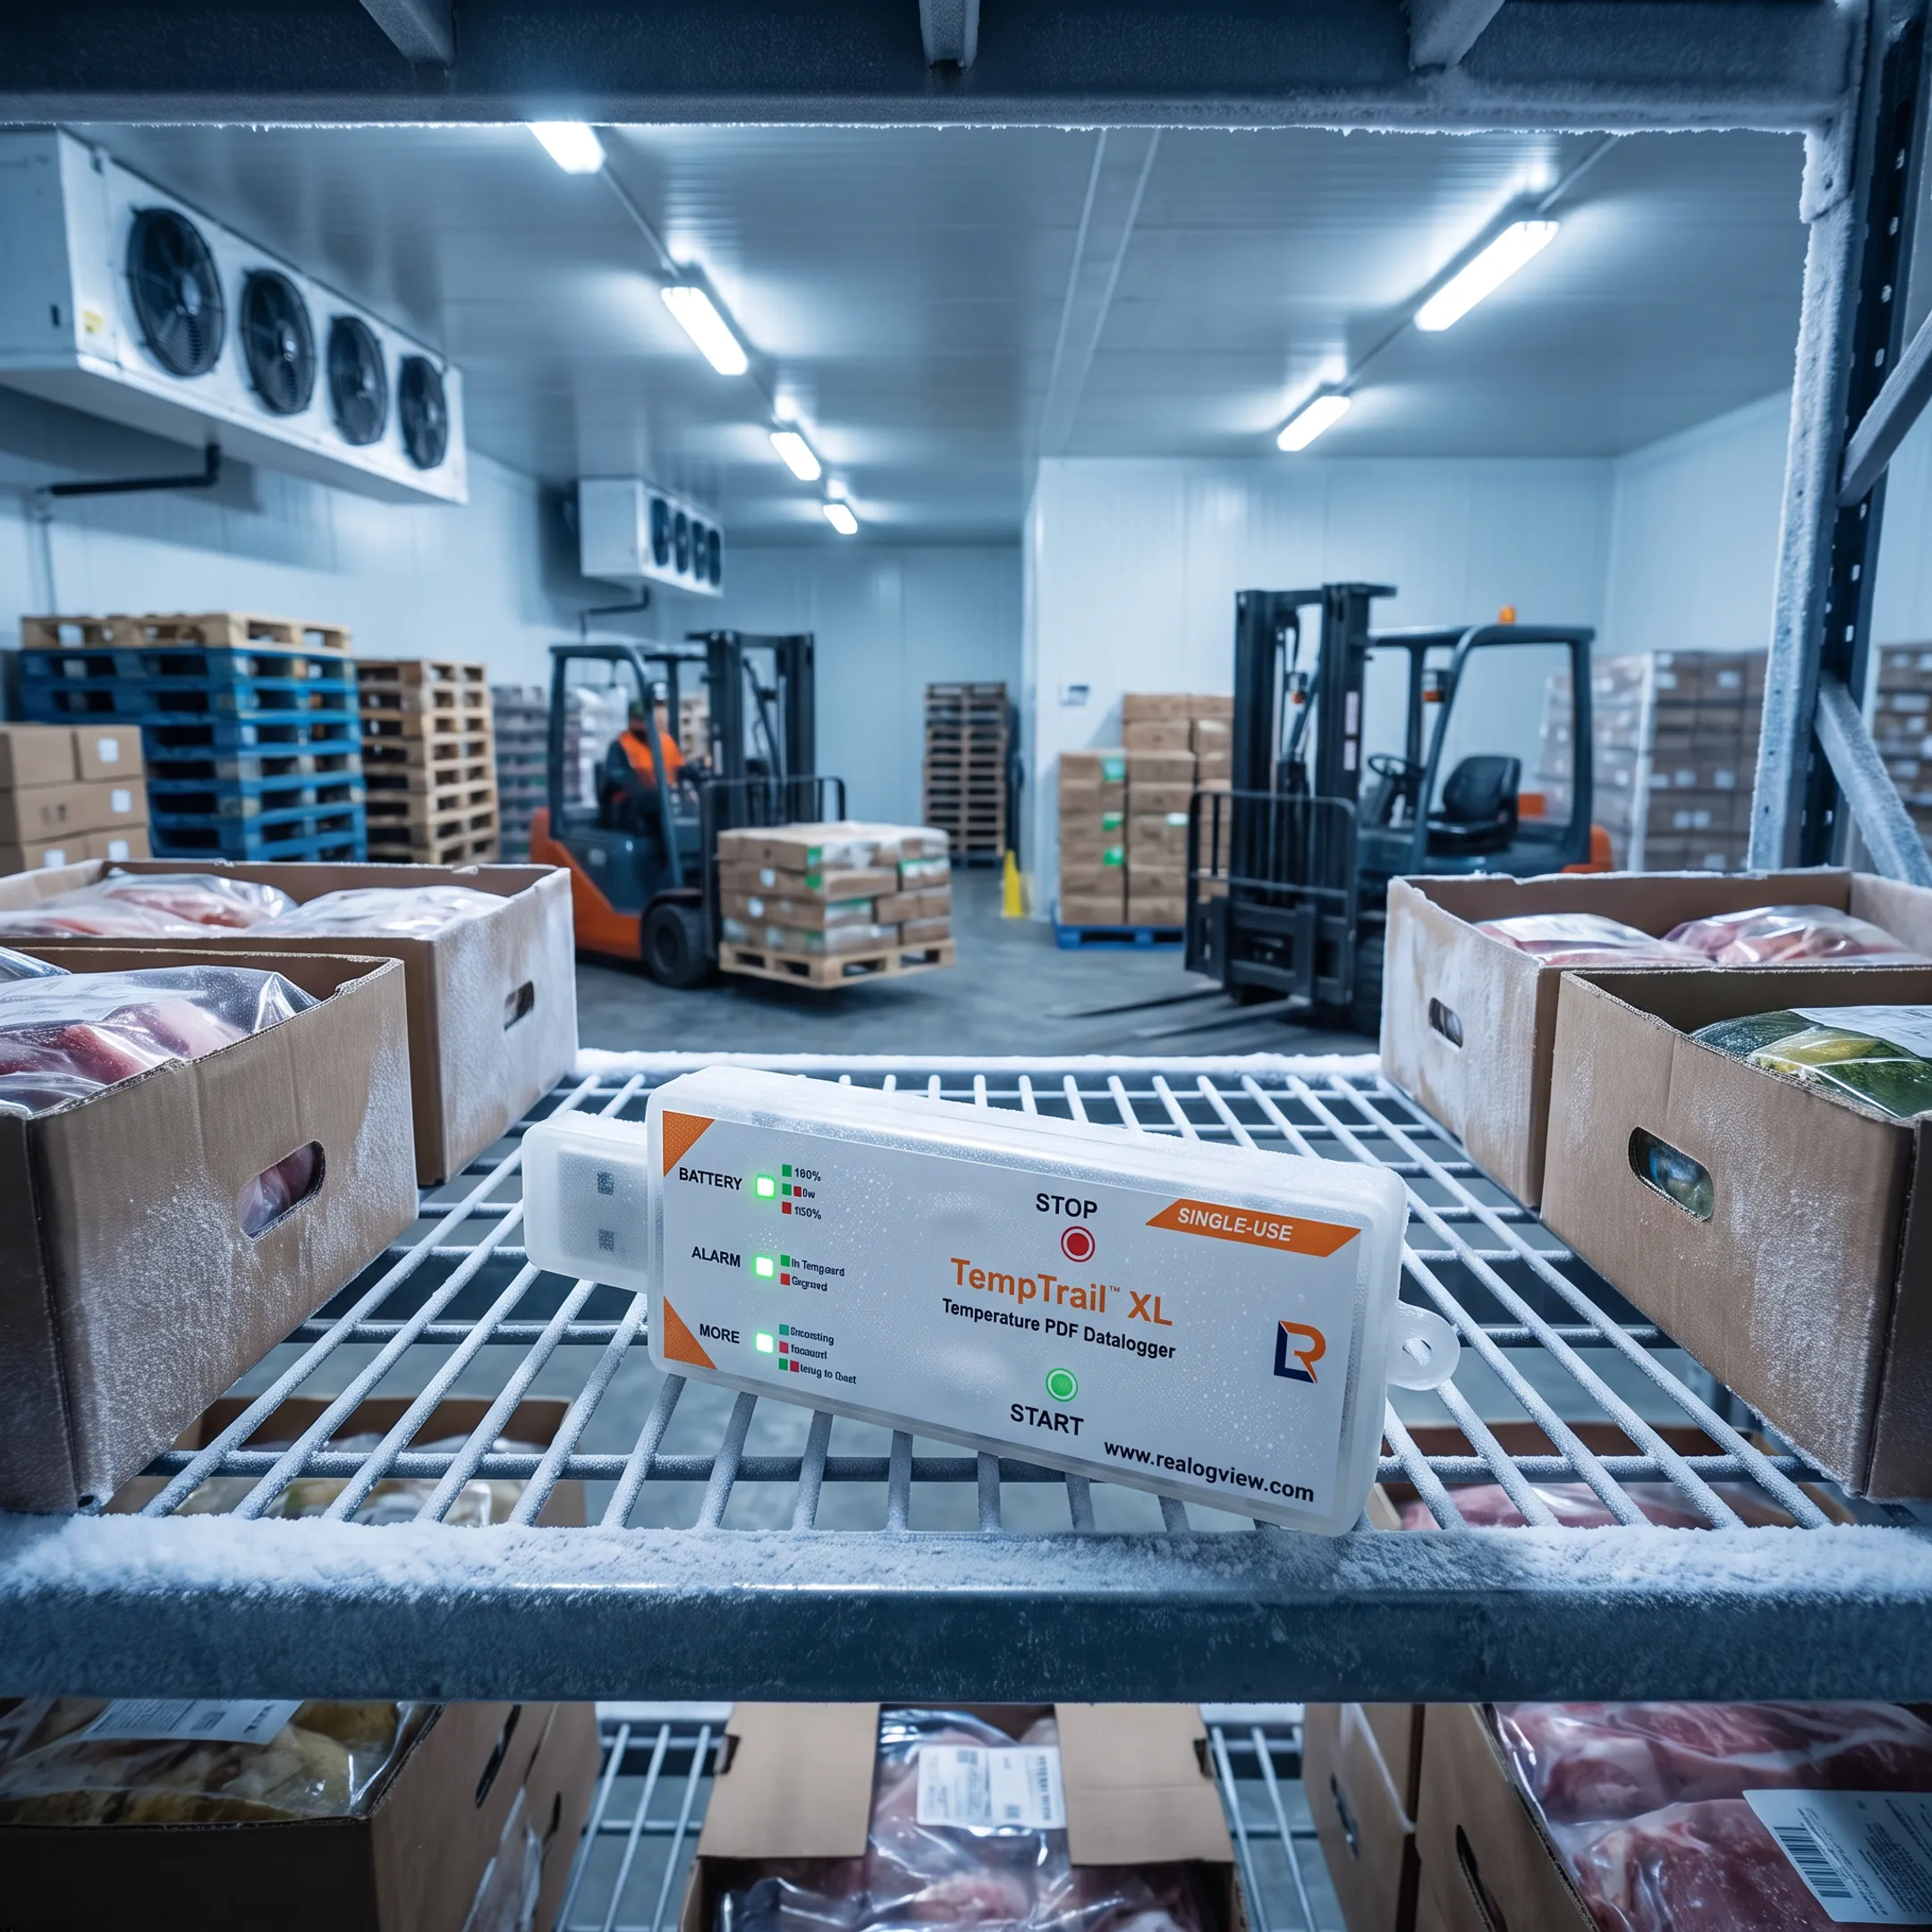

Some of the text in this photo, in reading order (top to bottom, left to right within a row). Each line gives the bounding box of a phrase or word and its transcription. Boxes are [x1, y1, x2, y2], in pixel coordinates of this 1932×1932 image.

[679, 1166, 742, 1191] BATTERY
[1036, 1193, 1097, 1219] STOP
[1178, 1208, 1293, 1242] SINGLE-USE
[691, 1246, 741, 1267] ALARM
[1127, 1291, 1173, 1326] XL
[699, 1323, 740, 1343] MORE
[943, 1298, 1176, 1359] Temperature PDF Datalogger
[824, 1369, 833, 1378] to
[1010, 1403, 1084, 1436] START
[1104, 1441, 1315, 1503] www.realogview.com
